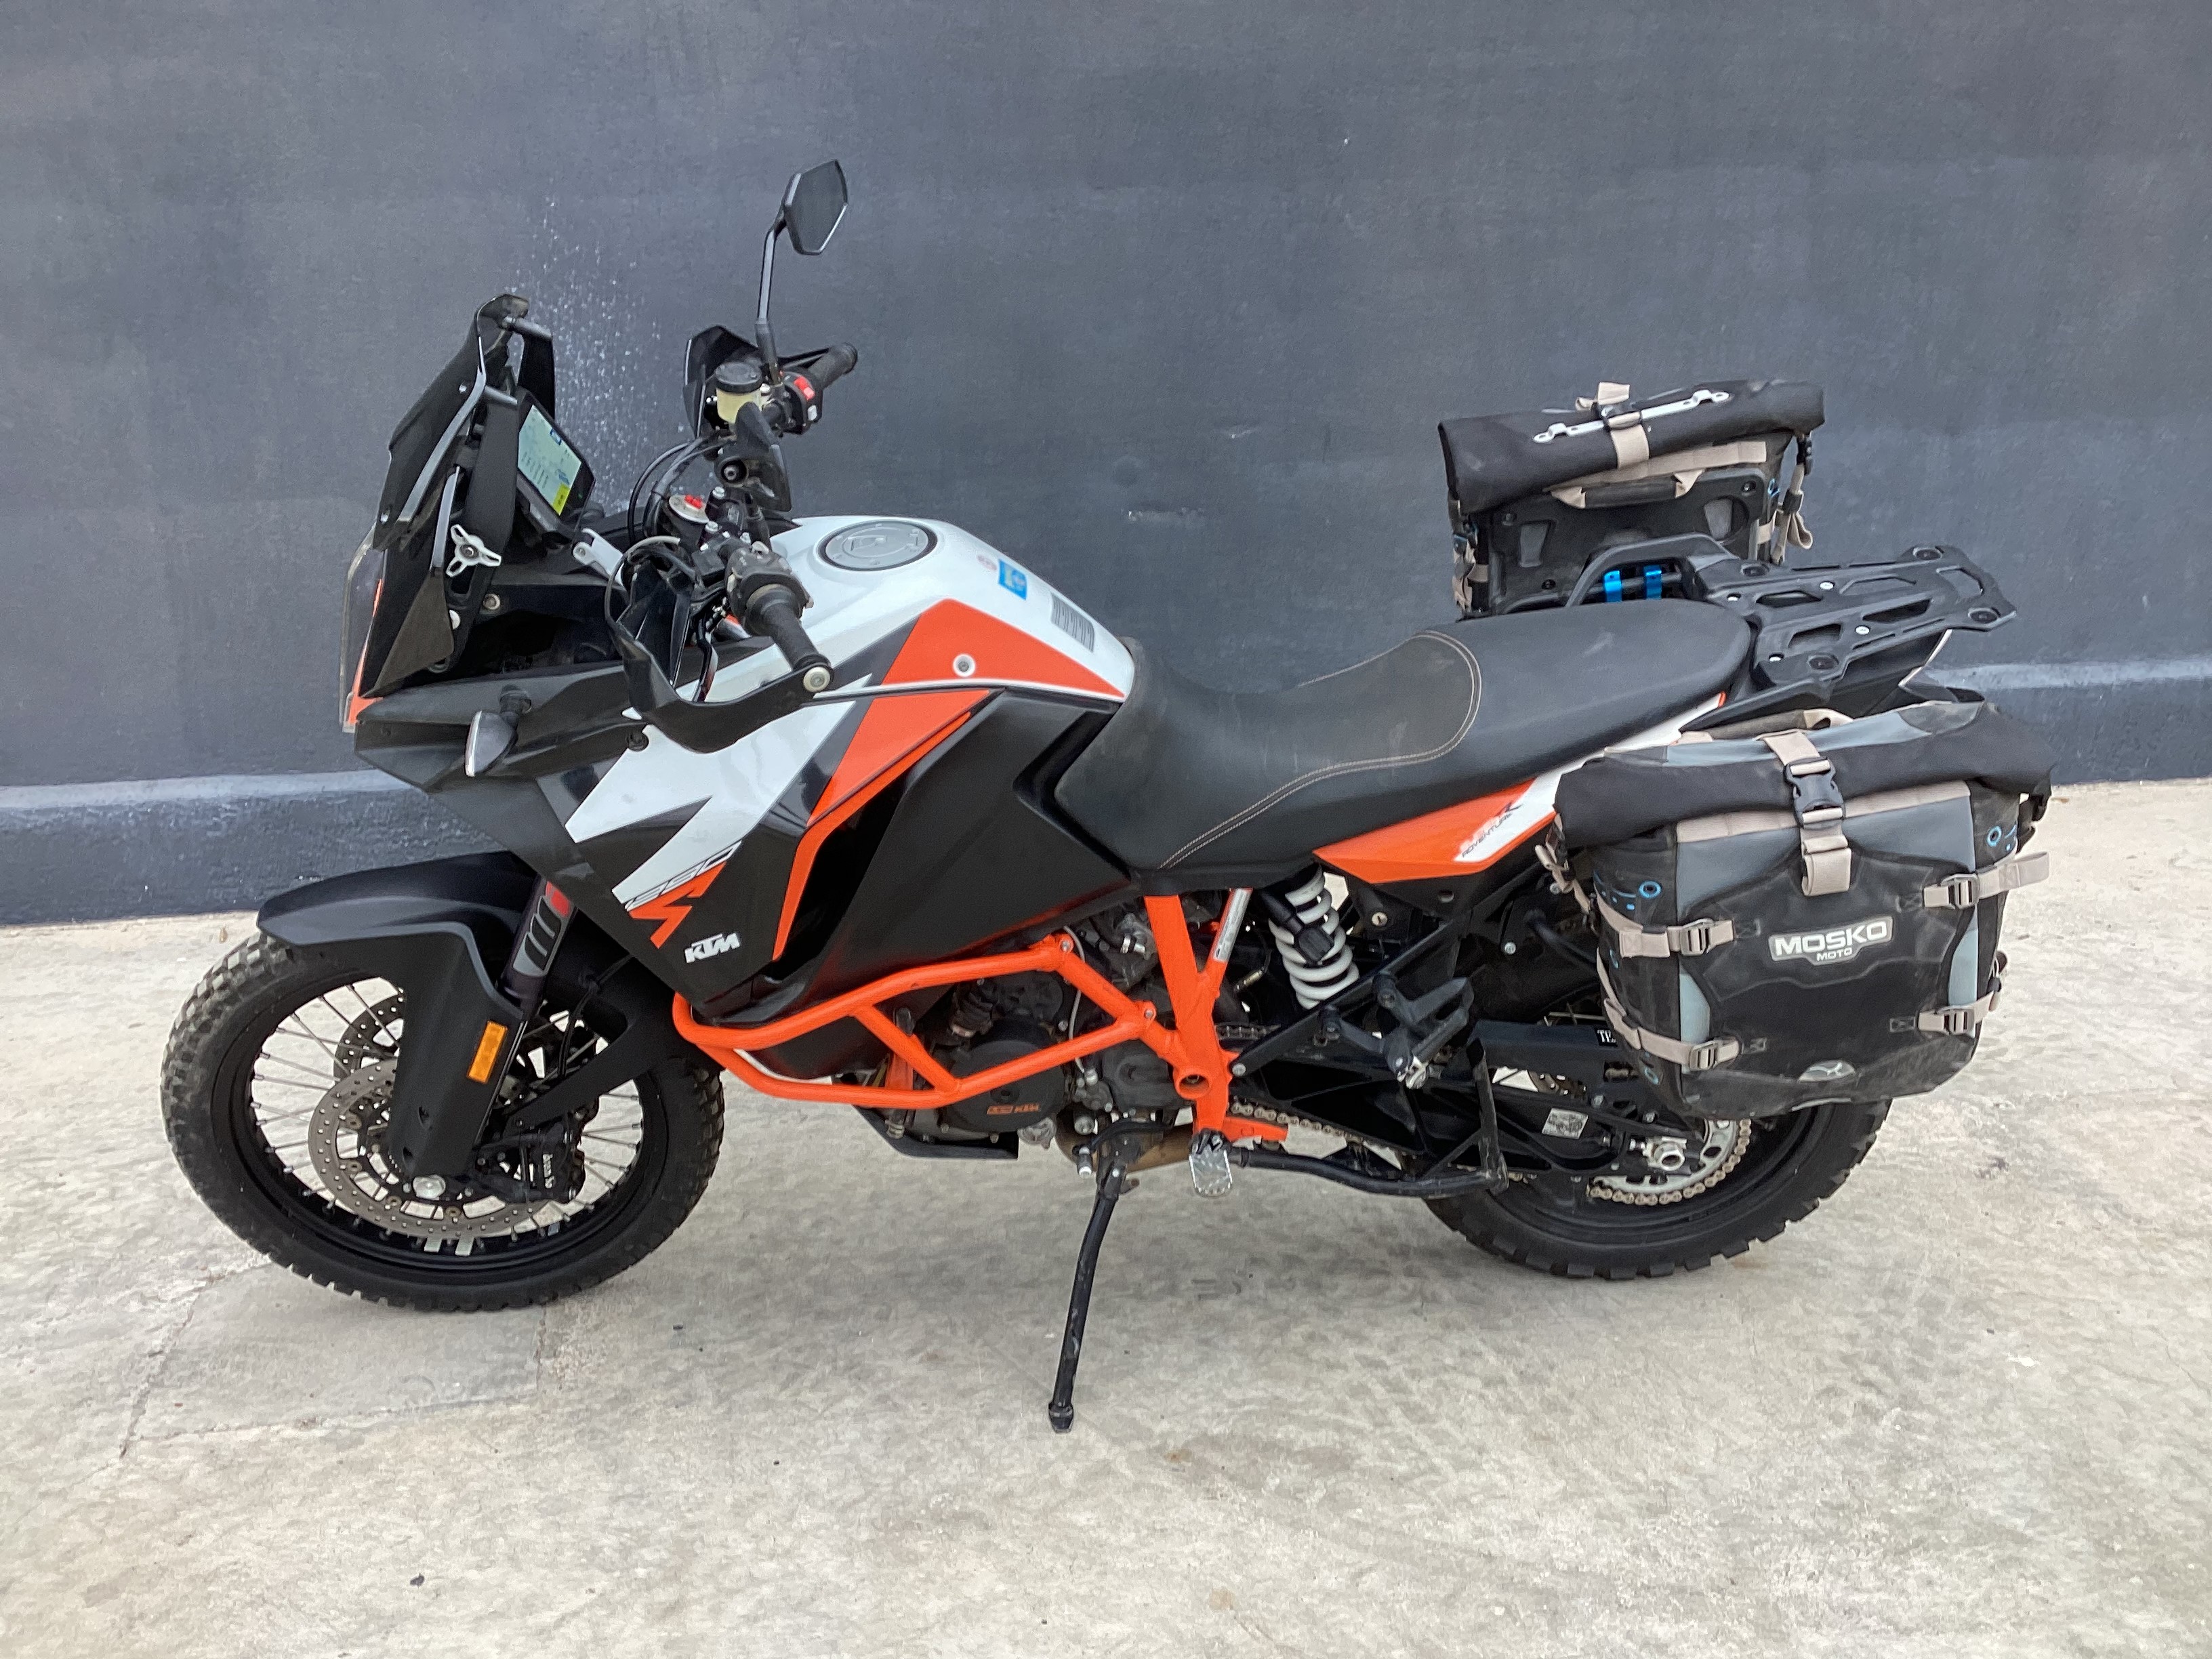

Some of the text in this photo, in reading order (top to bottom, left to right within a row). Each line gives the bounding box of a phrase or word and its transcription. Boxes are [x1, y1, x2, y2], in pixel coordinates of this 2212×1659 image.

[684, 933, 740, 963] KTM
[1774, 921, 1887, 956] MOSKO
[1816, 947, 1852, 962] MOTO
